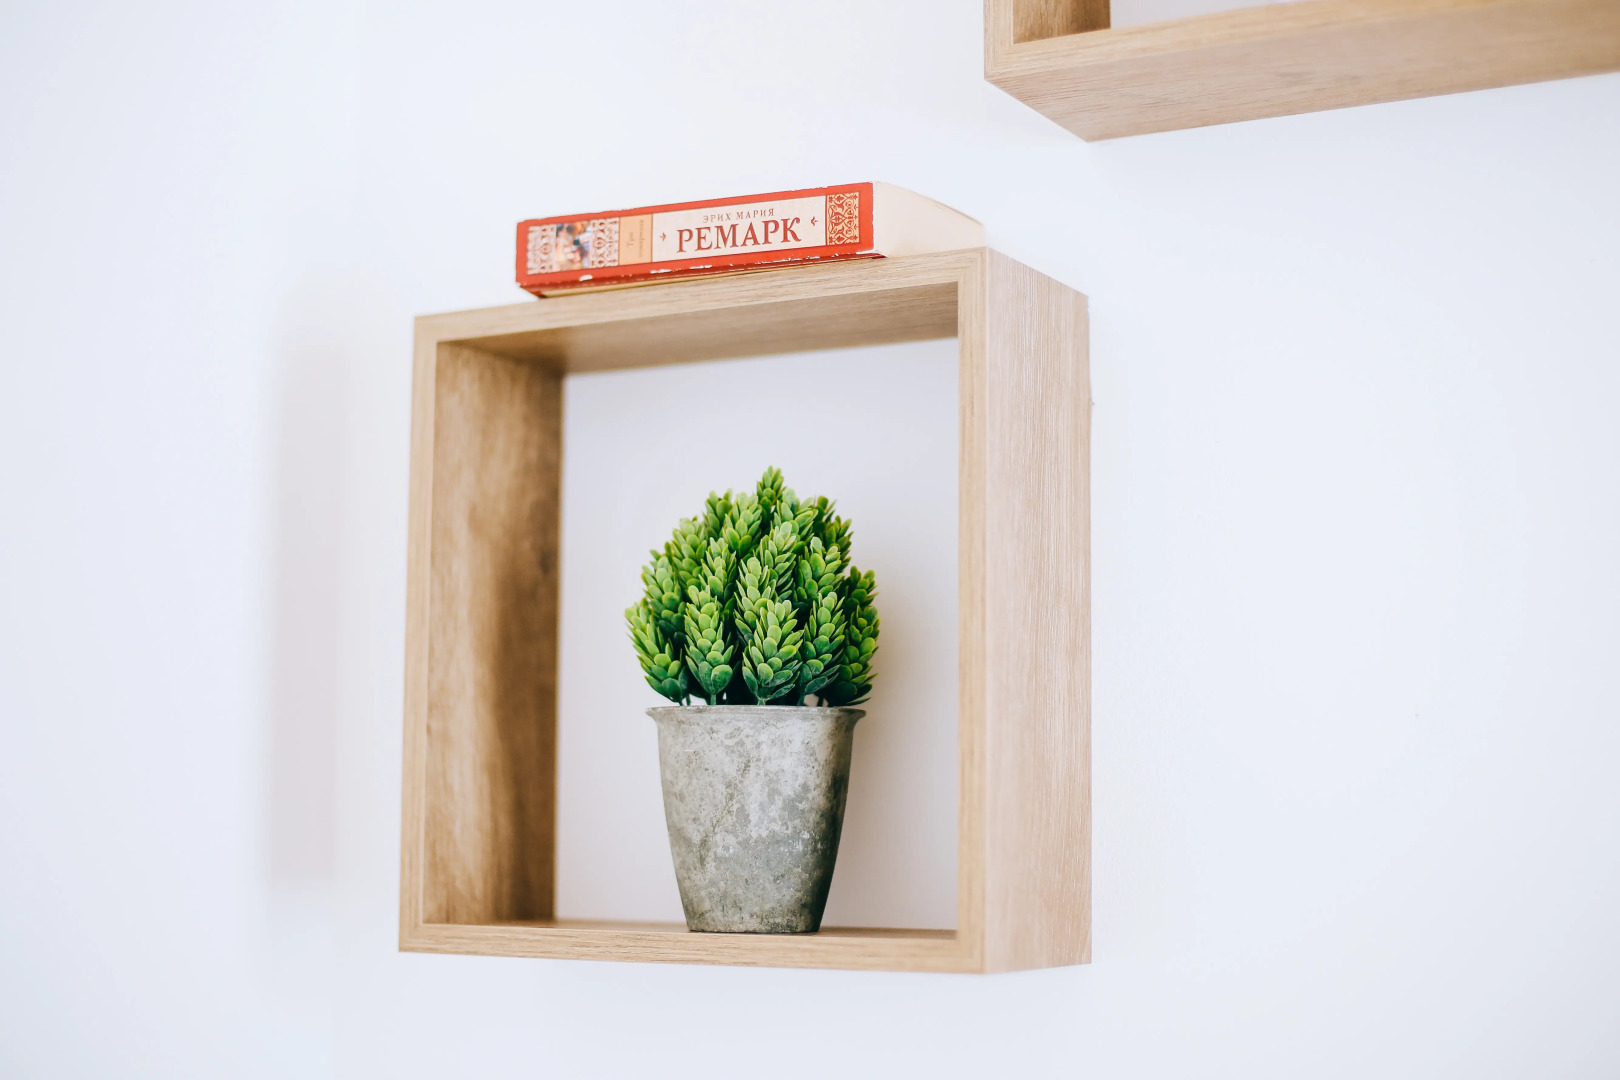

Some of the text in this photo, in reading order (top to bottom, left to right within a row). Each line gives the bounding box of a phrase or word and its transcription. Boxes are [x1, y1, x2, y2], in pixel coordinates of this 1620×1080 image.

[702, 207, 775, 223] ЭРИХ МАРИЯ
[677, 217, 801, 253] РЕМАРК
